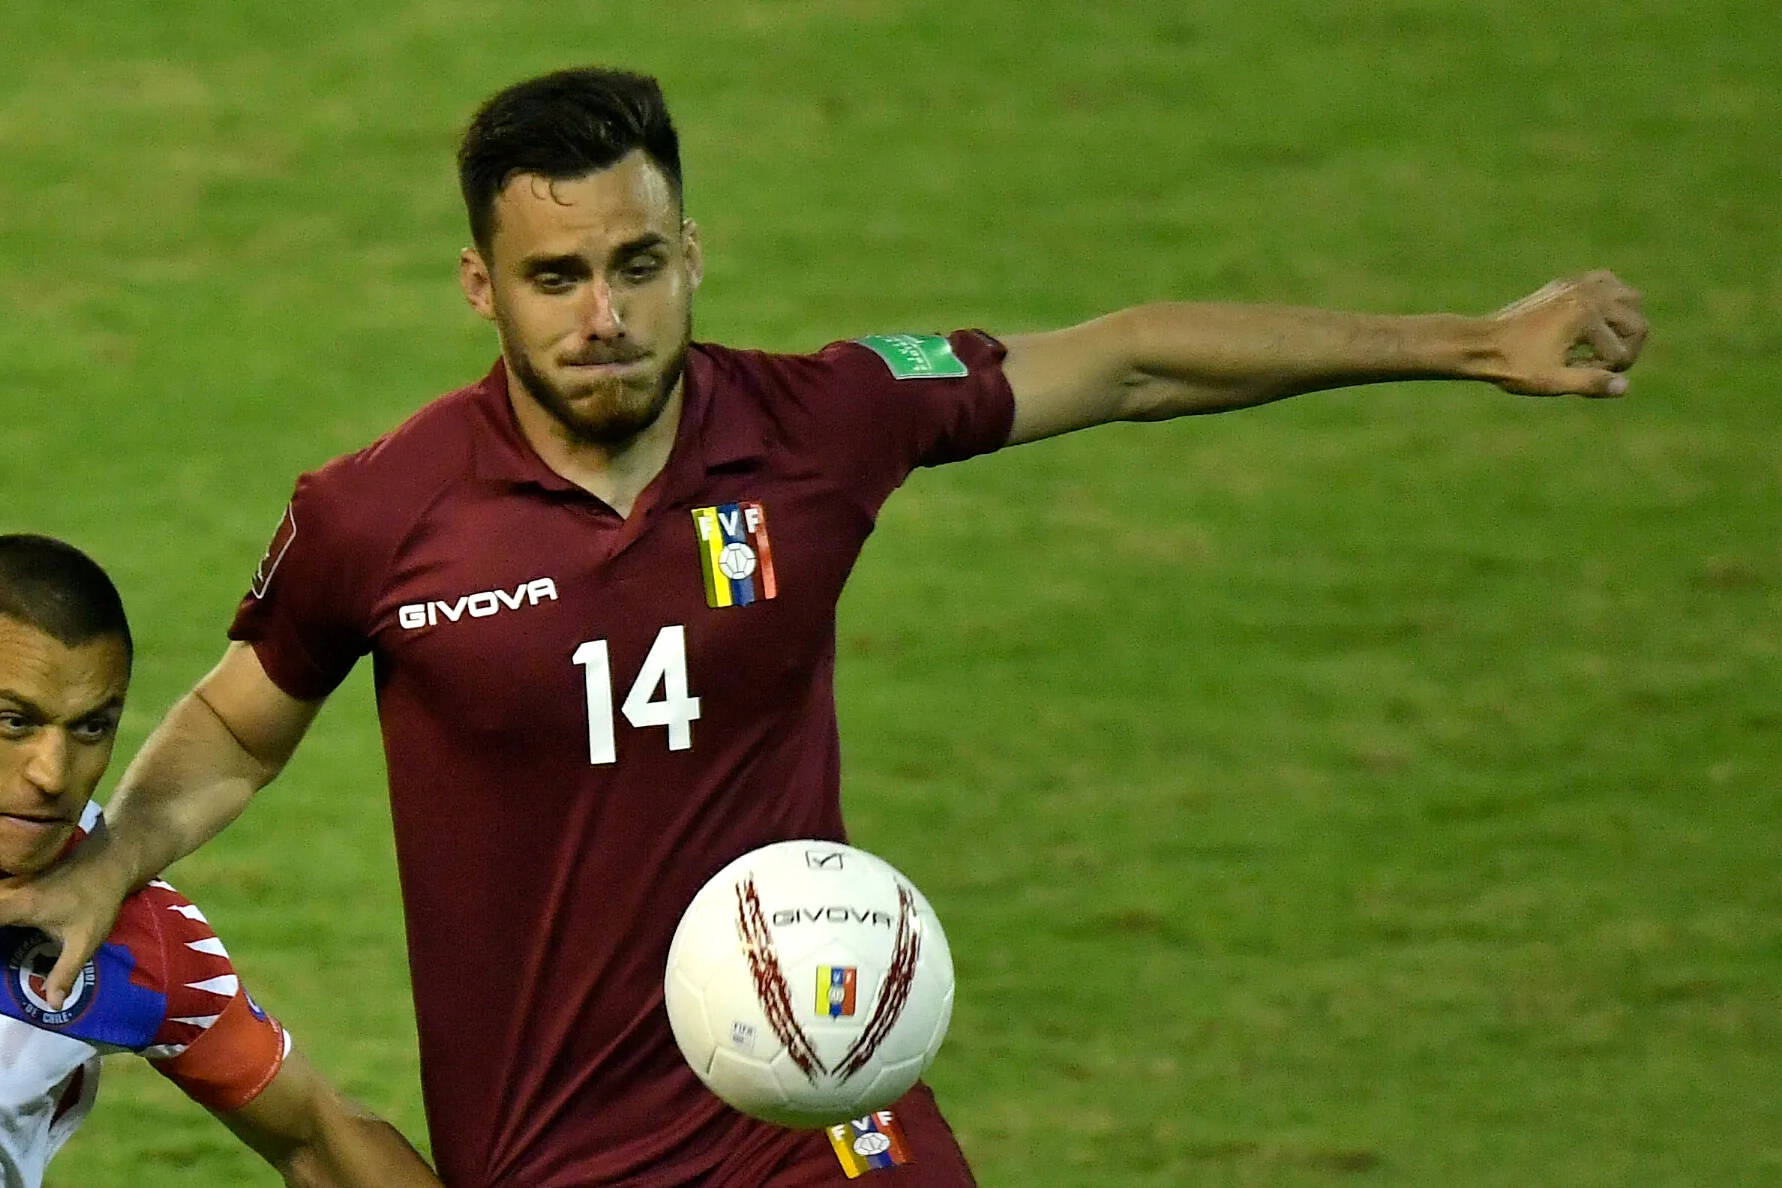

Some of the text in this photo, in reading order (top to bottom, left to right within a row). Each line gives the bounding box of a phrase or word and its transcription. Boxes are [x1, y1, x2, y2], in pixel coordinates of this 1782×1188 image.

[698, 508, 761, 541] FVF
[399, 577, 559, 629] GIVOVA
[572, 625, 701, 764] 14
[773, 906, 893, 929] GIVOVA
[42, 1012, 70, 1024] CHILE
[831, 1111, 893, 1141] FVF
